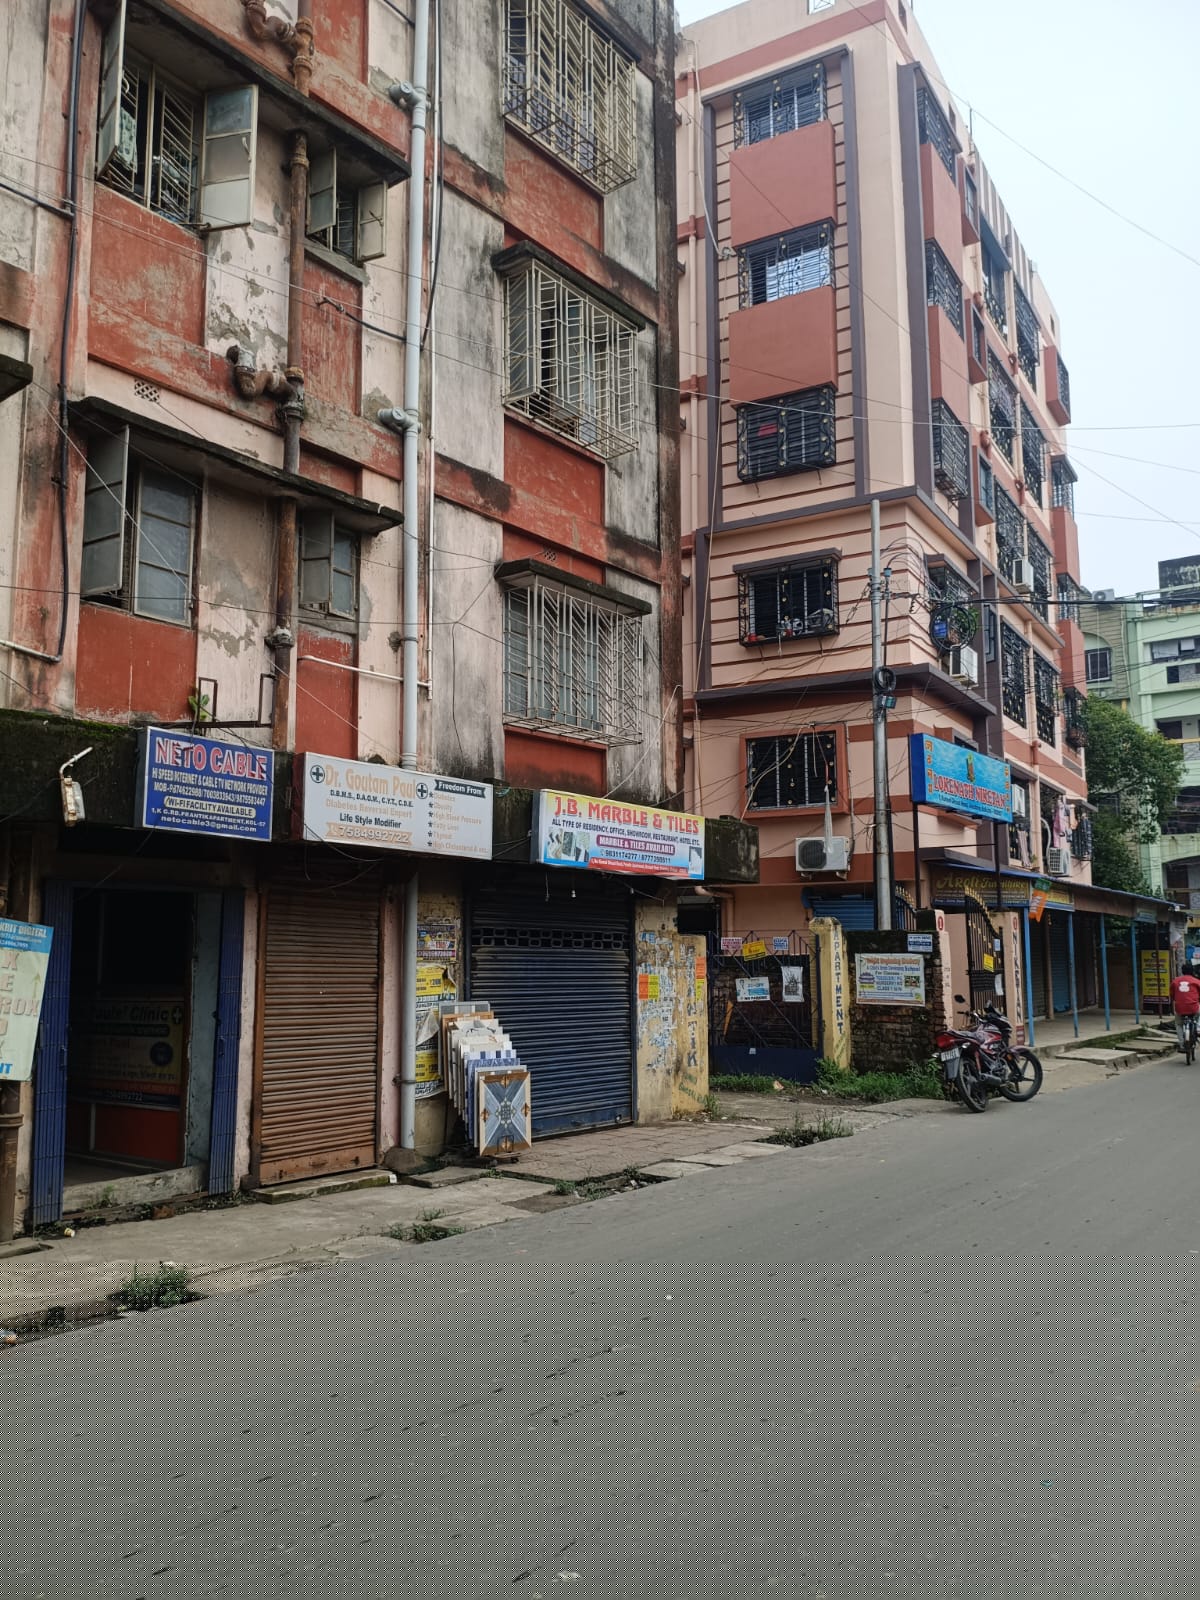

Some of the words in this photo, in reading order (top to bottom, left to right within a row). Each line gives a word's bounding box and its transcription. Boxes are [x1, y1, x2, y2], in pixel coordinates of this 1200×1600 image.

[155, 736, 207, 771] NETO
[210, 746, 268, 781] CABLE
[158, 769, 174, 781] SPEED
[174, 771, 198, 786] INTERNET
[247, 783, 268, 796] PROVIDER
[325, 764, 341, 788] Dr.
[346, 768, 389, 795] Goutam
[393, 776, 416, 799] Paul
[438, 780, 466, 792] Freedom
[466, 786, 483, 796] From
[933, 773, 974, 800] LOKENATH
[975, 786, 1006, 807] NIKETAN
[217, 802, 253, 817] AVAILABLE
[325, 798, 357, 811] Diabetes
[360, 803, 389, 815] Reversal
[391, 806, 412, 819] Expert
[554, 796, 582, 817] J.B.
[588, 802, 649, 827] MARBLE
[653, 813, 662, 829] &
[666, 815, 699, 834] TILES
[340, 812, 353, 822] Life
[355, 815, 373, 826] Style
[374, 818, 402, 828] Modifier
[552, 818, 562, 827] ALL
[562, 820, 575, 829] TYPE
[575, 821, 582, 830] OF
[339, 825, 409, 843] 7584992722
[599, 836, 624, 848] MARBLE
[624, 839, 630, 848] &
[630, 840, 646, 851] TILES
[646, 842, 674, 854] AVAILABLE
[833, 931, 844, 1034] APARTMENT
[1012, 930, 1022, 1024] NIKETAN
[129, 1006, 168, 1020] Clinic
